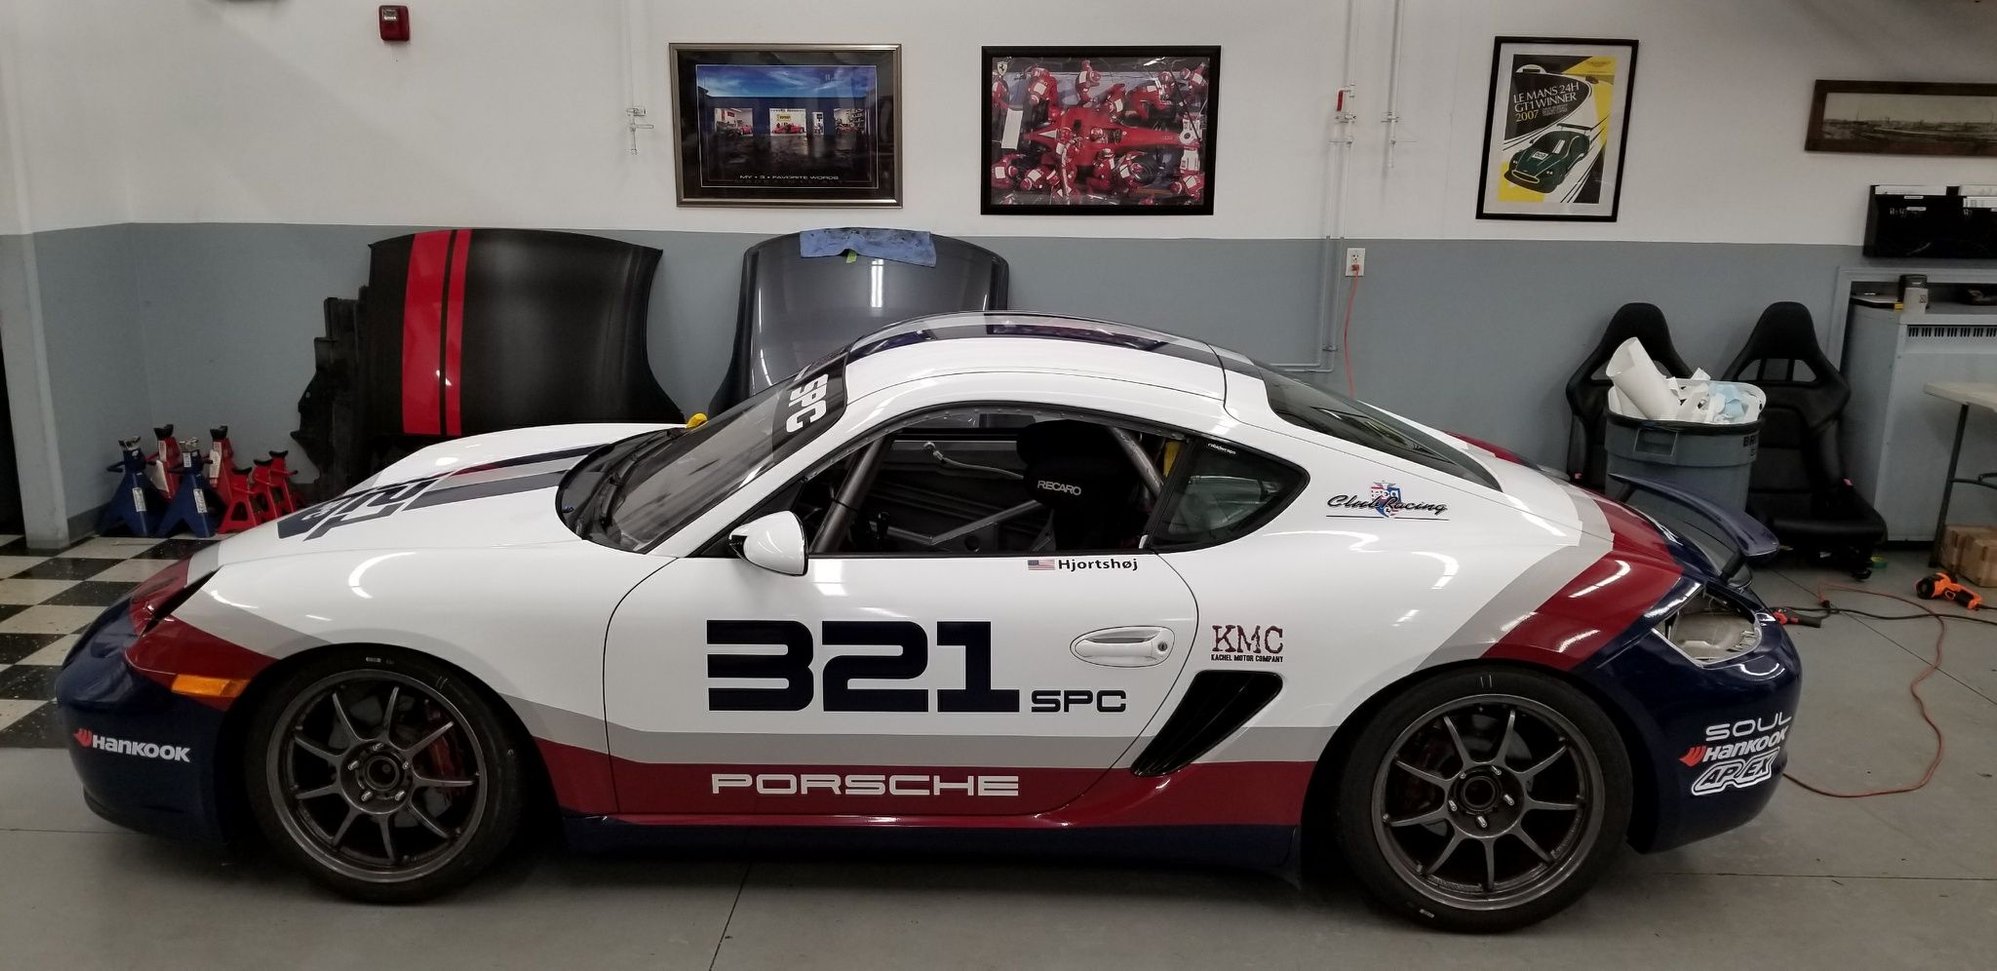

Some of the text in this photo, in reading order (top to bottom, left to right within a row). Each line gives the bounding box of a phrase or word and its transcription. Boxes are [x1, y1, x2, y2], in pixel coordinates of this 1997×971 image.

[1513, 81, 1580, 104] LE MANS 24H
[1514, 101, 1535, 113] GT1
[1536, 92, 1577, 108] WINNER
[1515, 109, 1539, 122] 2007
[786, 373, 829, 433] SPC
[1037, 480, 1082, 496] RECARO
[1326, 494, 1449, 516] Club Racing
[1058, 559, 1138, 572] Hjortshøj
[1211, 624, 1284, 654] KMC
[706, 619, 1127, 713] 321 SPC
[1705, 711, 1792, 742] SOUL
[1694, 749, 1779, 793] APEX
[711, 773, 1019, 796] PORSCHE
